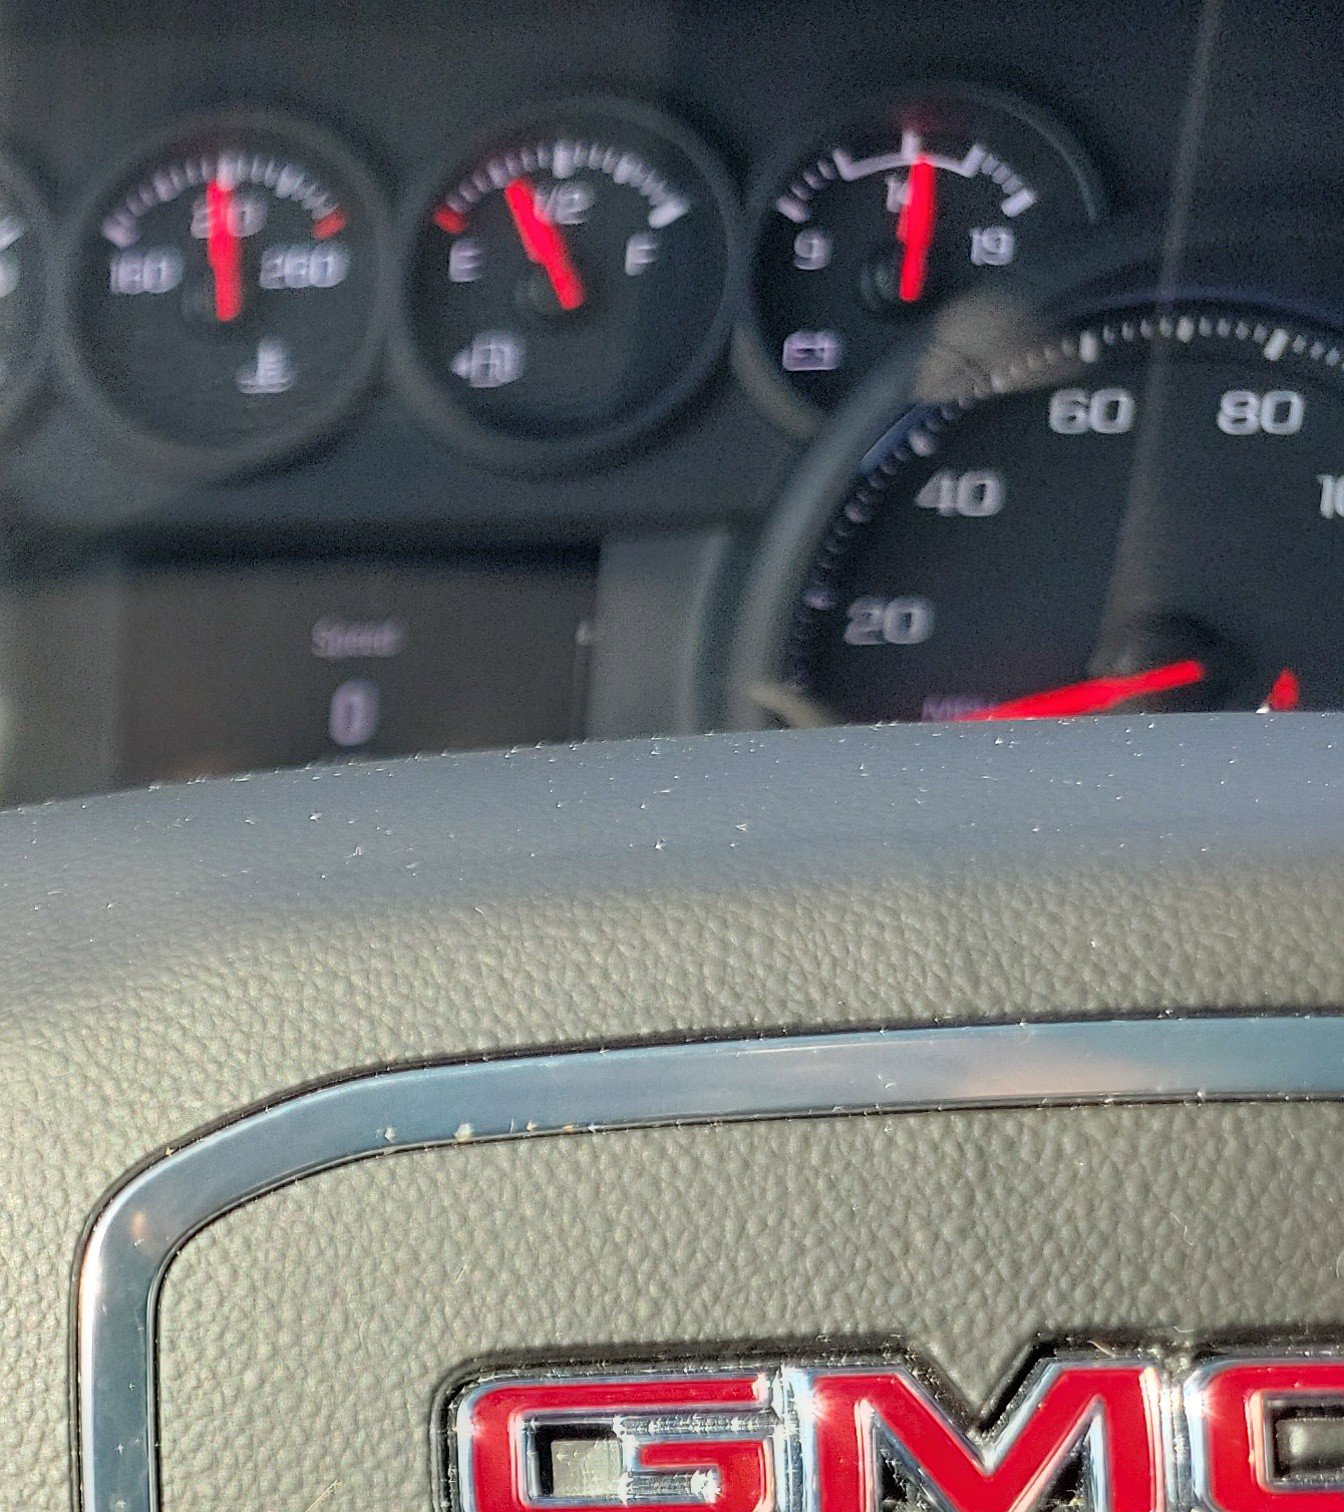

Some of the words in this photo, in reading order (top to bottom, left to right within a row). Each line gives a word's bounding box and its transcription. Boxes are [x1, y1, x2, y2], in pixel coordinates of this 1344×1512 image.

[794, 230, 833, 271] 9
[970, 226, 1017, 267] 19
[1048, 387, 1135, 435] 60
[1216, 389, 1305, 436] 80
[916, 470, 1005, 518] 40
[843, 597, 934, 646] 20
[329, 679, 379, 746] 0
